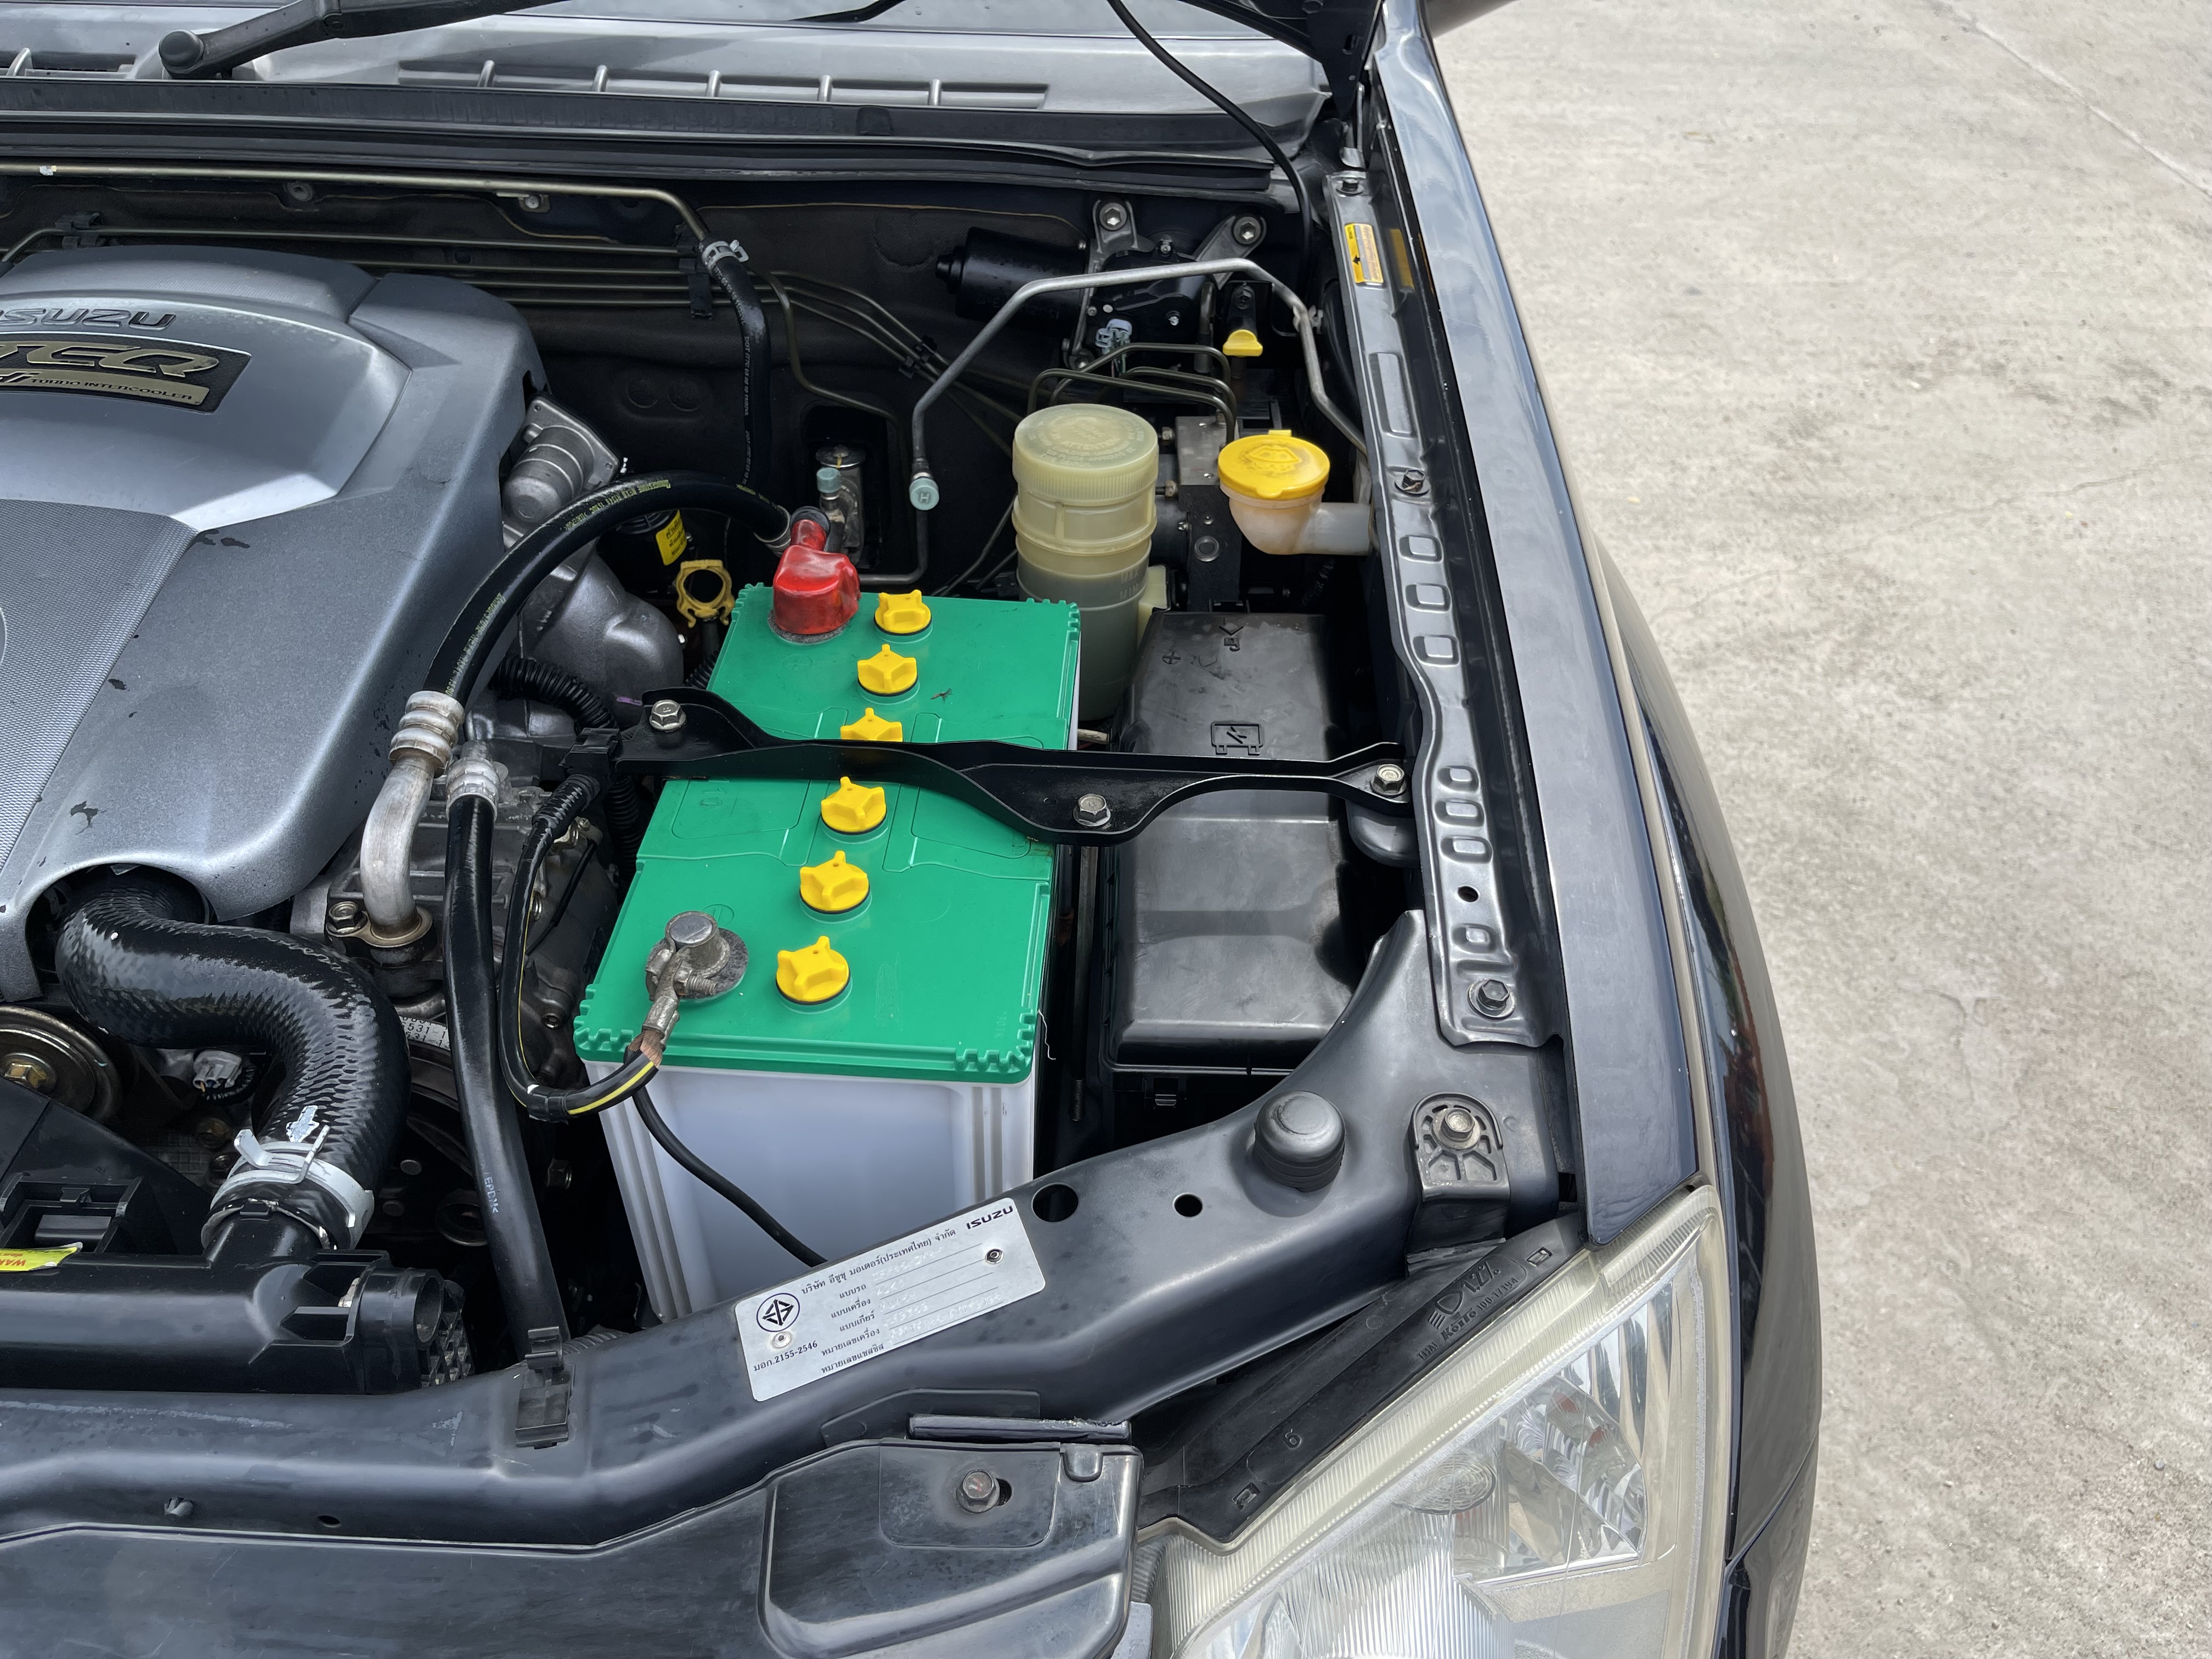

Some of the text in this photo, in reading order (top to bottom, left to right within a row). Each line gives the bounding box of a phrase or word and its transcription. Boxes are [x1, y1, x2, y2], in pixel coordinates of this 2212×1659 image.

[0, 308, 177, 330] SUZU
[84, 382, 193, 400] INTERCOOLER
[966, 1205, 1013, 1230] ISUZU
[801, 1278, 826, 1295] บริษัท
[849, 1236, 932, 1278] มอเตอร์(ประเทศไทย)
[934, 1227, 957, 1244] จำกัด
[839, 1283, 867, 1299] แบบรถ
[831, 1296, 871, 1319] แบบเครื่อง
[839, 1310, 876, 1333] แบบเกียร์
[821, 1327, 881, 1357] หมายเลขเครื่อง
[754, 1340, 818, 1372] มอก.2155-2546
